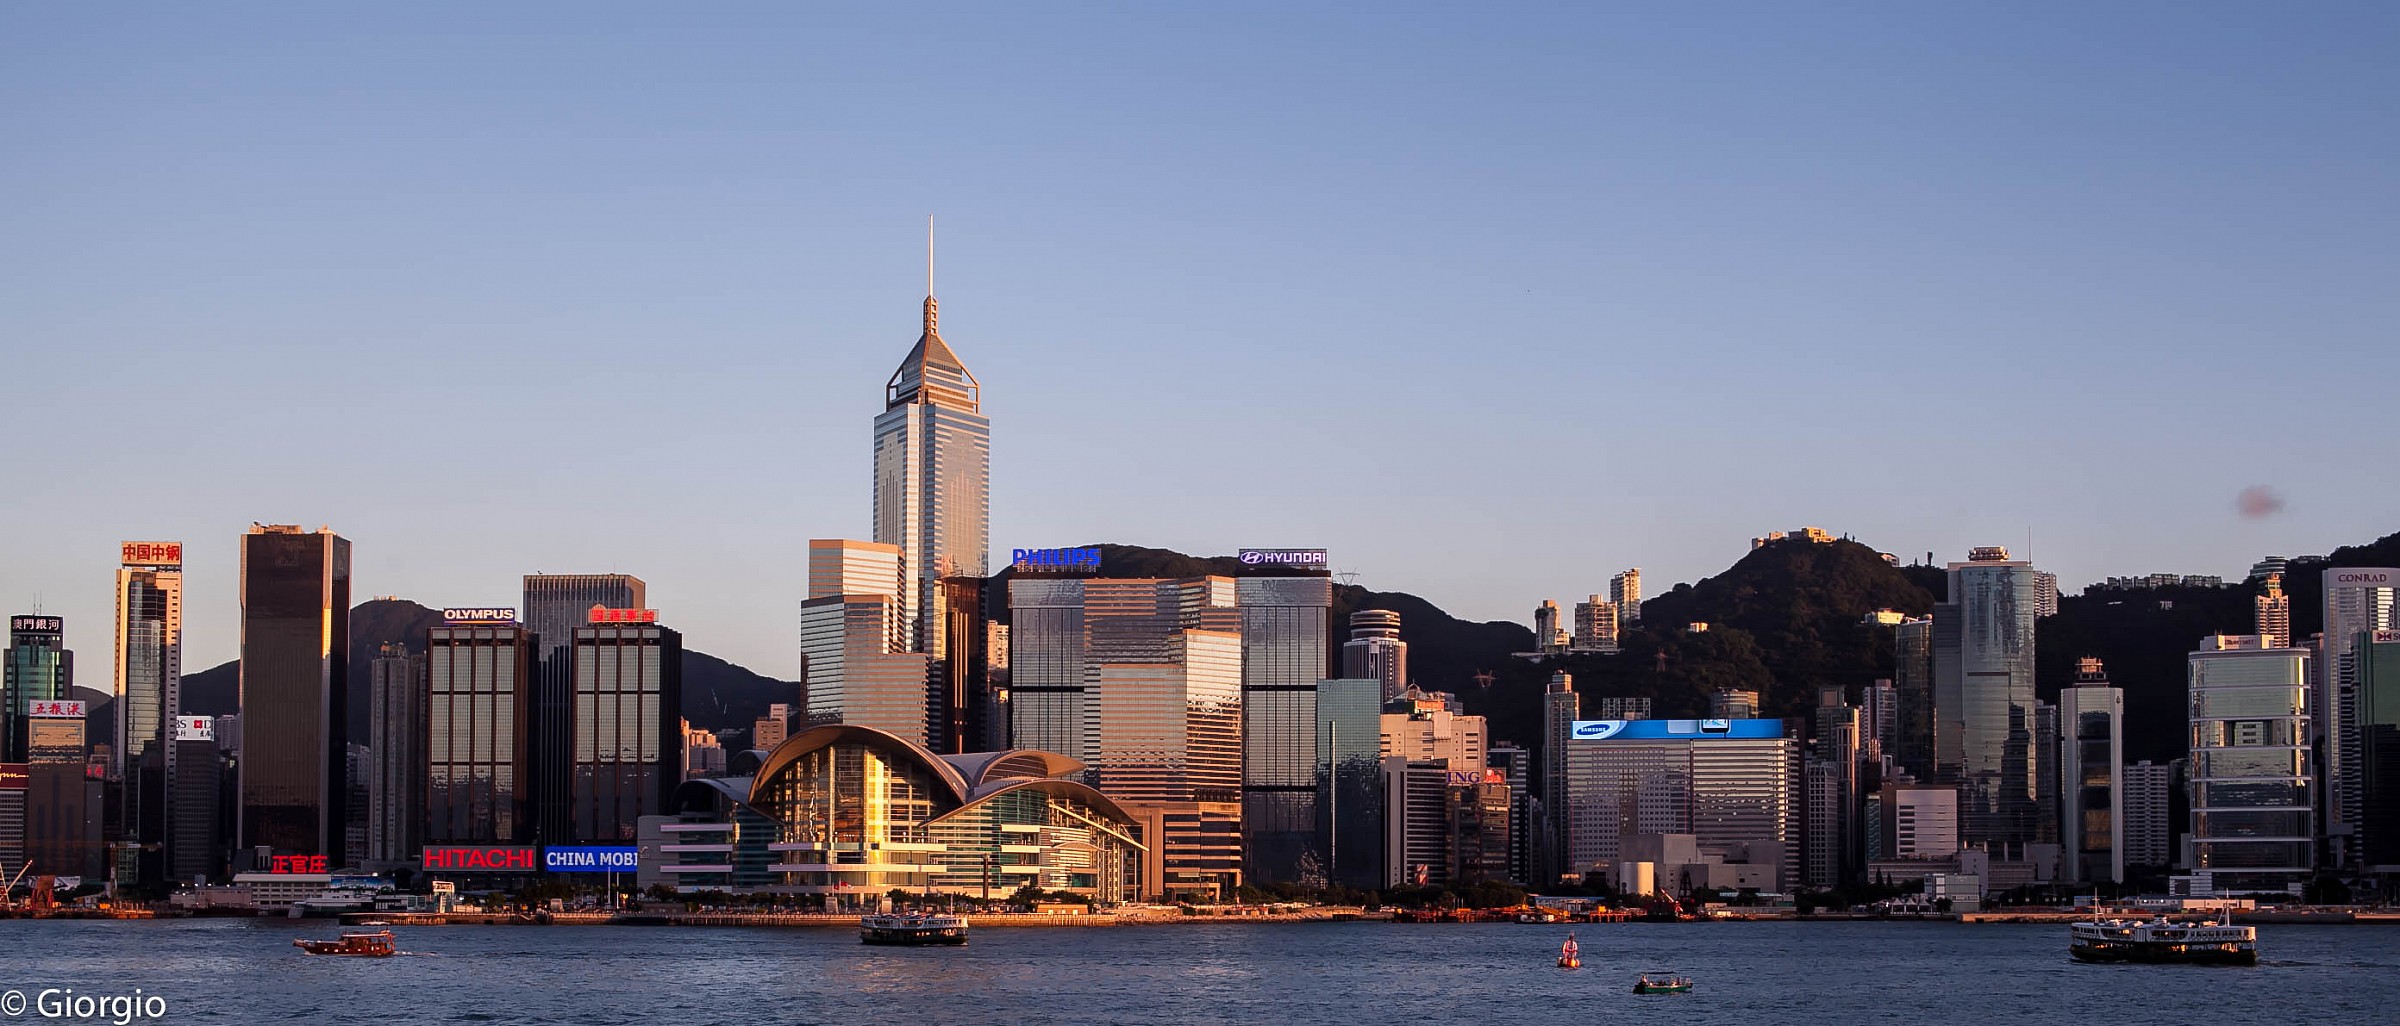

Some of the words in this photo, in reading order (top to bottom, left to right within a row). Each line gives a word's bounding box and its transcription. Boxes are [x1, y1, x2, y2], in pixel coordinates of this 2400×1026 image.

[1012, 548, 1101, 565] PHILIPS
[1265, 552, 1326, 563] HYUNDAI
[2338, 573, 2387, 582] CONRAD
[444, 609, 514, 619] OLYMPUS
[12, 618, 60, 631] 澳門銀河
[1447, 771, 1480, 783] ING
[271, 854, 328, 874] 正官庄
[424, 848, 534, 869] HITACHI
[546, 852, 595, 867] CHINA
